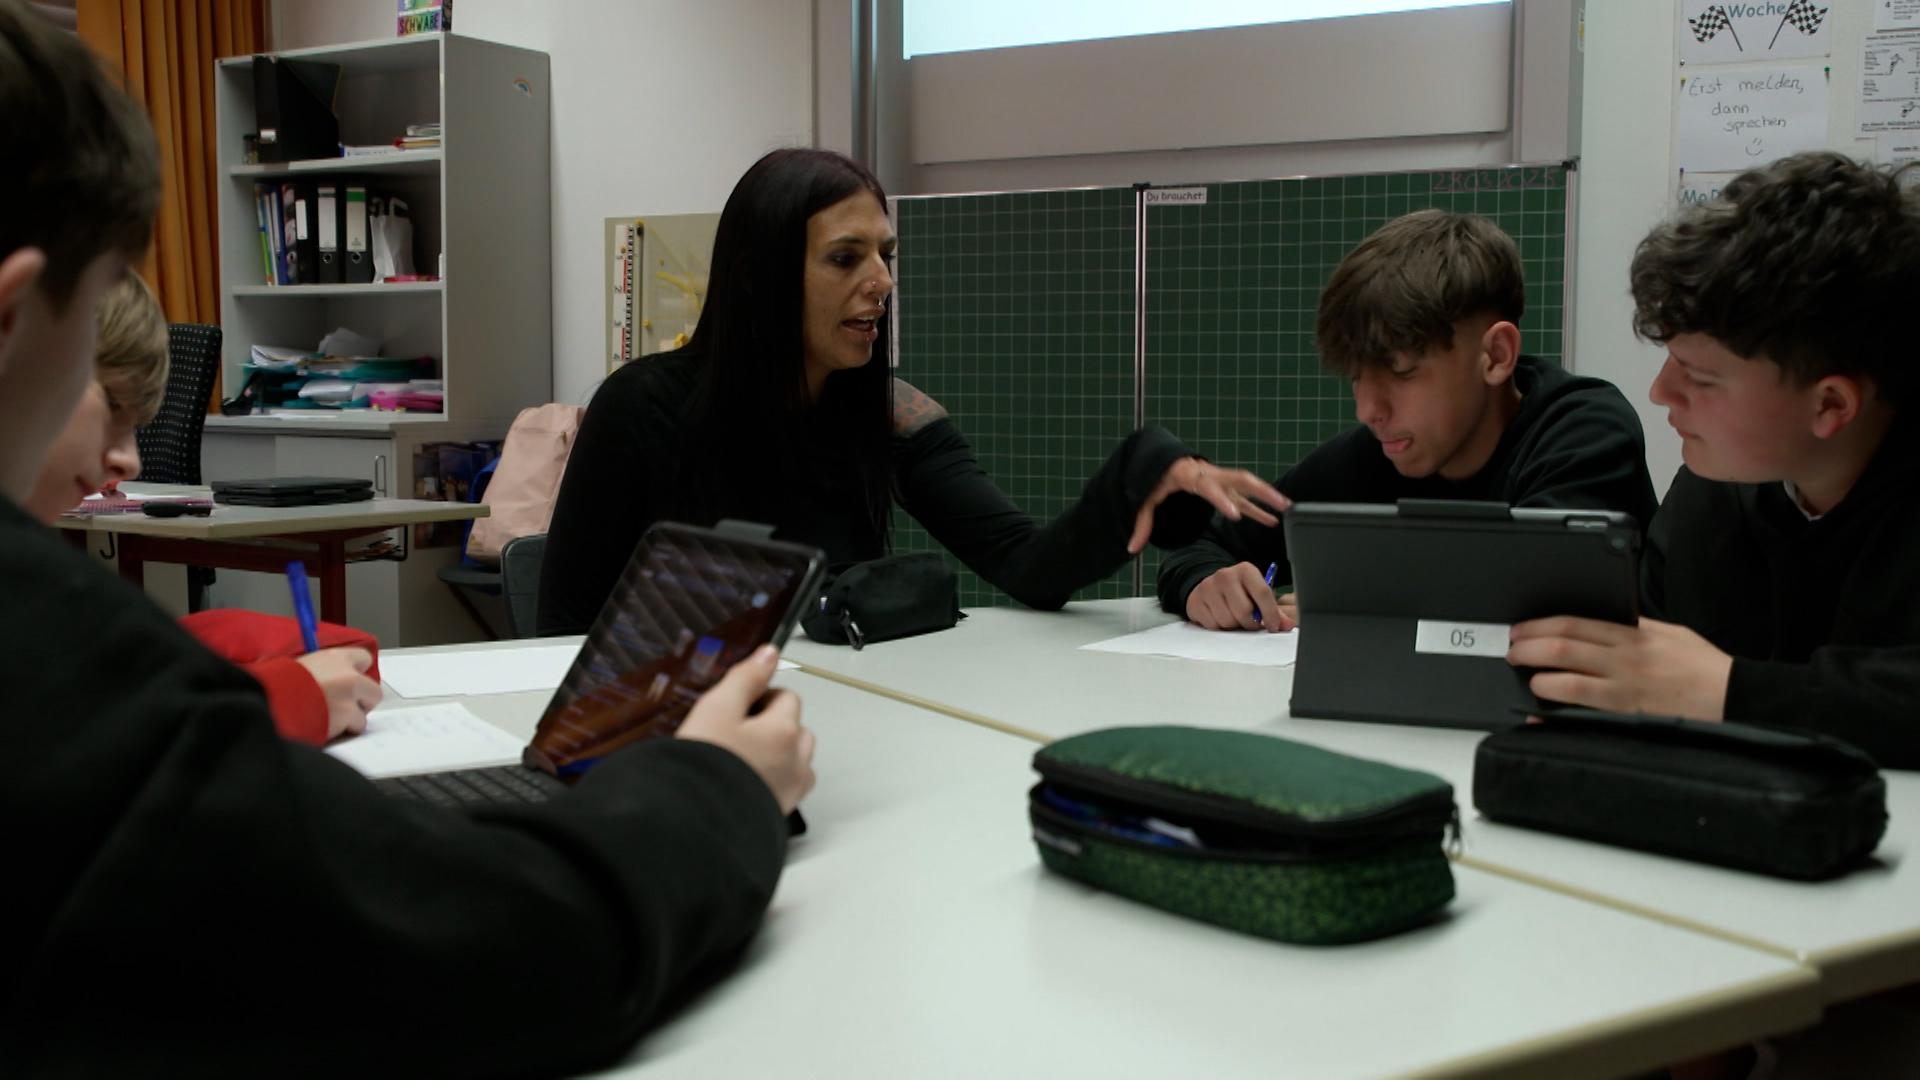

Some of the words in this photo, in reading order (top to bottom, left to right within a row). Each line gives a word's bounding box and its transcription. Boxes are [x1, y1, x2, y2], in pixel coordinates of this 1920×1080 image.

[1728, 2, 1786, 18] Woche
[1689, 76, 1722, 96] Erst
[1738, 73, 1804, 94] melden,
[1711, 102, 1750, 116] dann
[1723, 116, 1786, 135] sprechen
[1146, 192, 1159, 201] Du
[1450, 628, 1475, 648] 05
